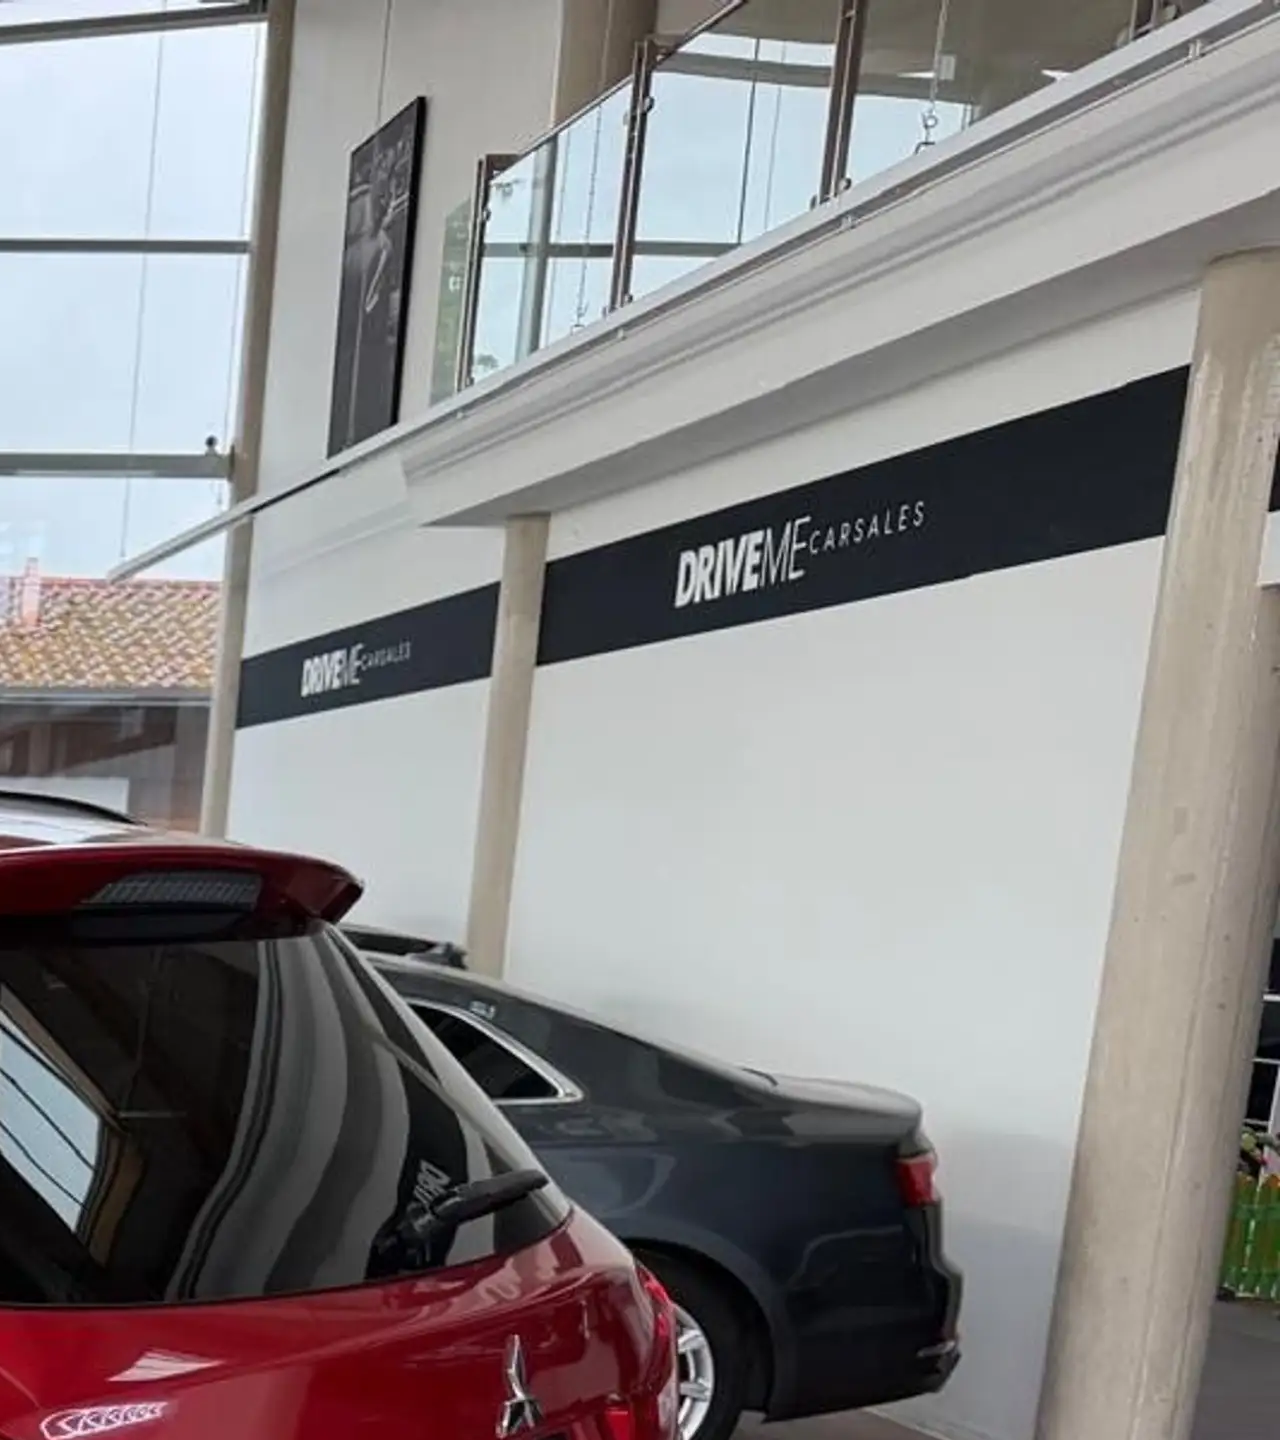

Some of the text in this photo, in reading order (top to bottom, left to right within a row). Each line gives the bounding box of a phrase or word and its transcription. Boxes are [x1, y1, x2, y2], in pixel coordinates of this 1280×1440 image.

[674, 500, 926, 608] DRIVEME CARSALES
[301, 642, 365, 697] DRIVEME
